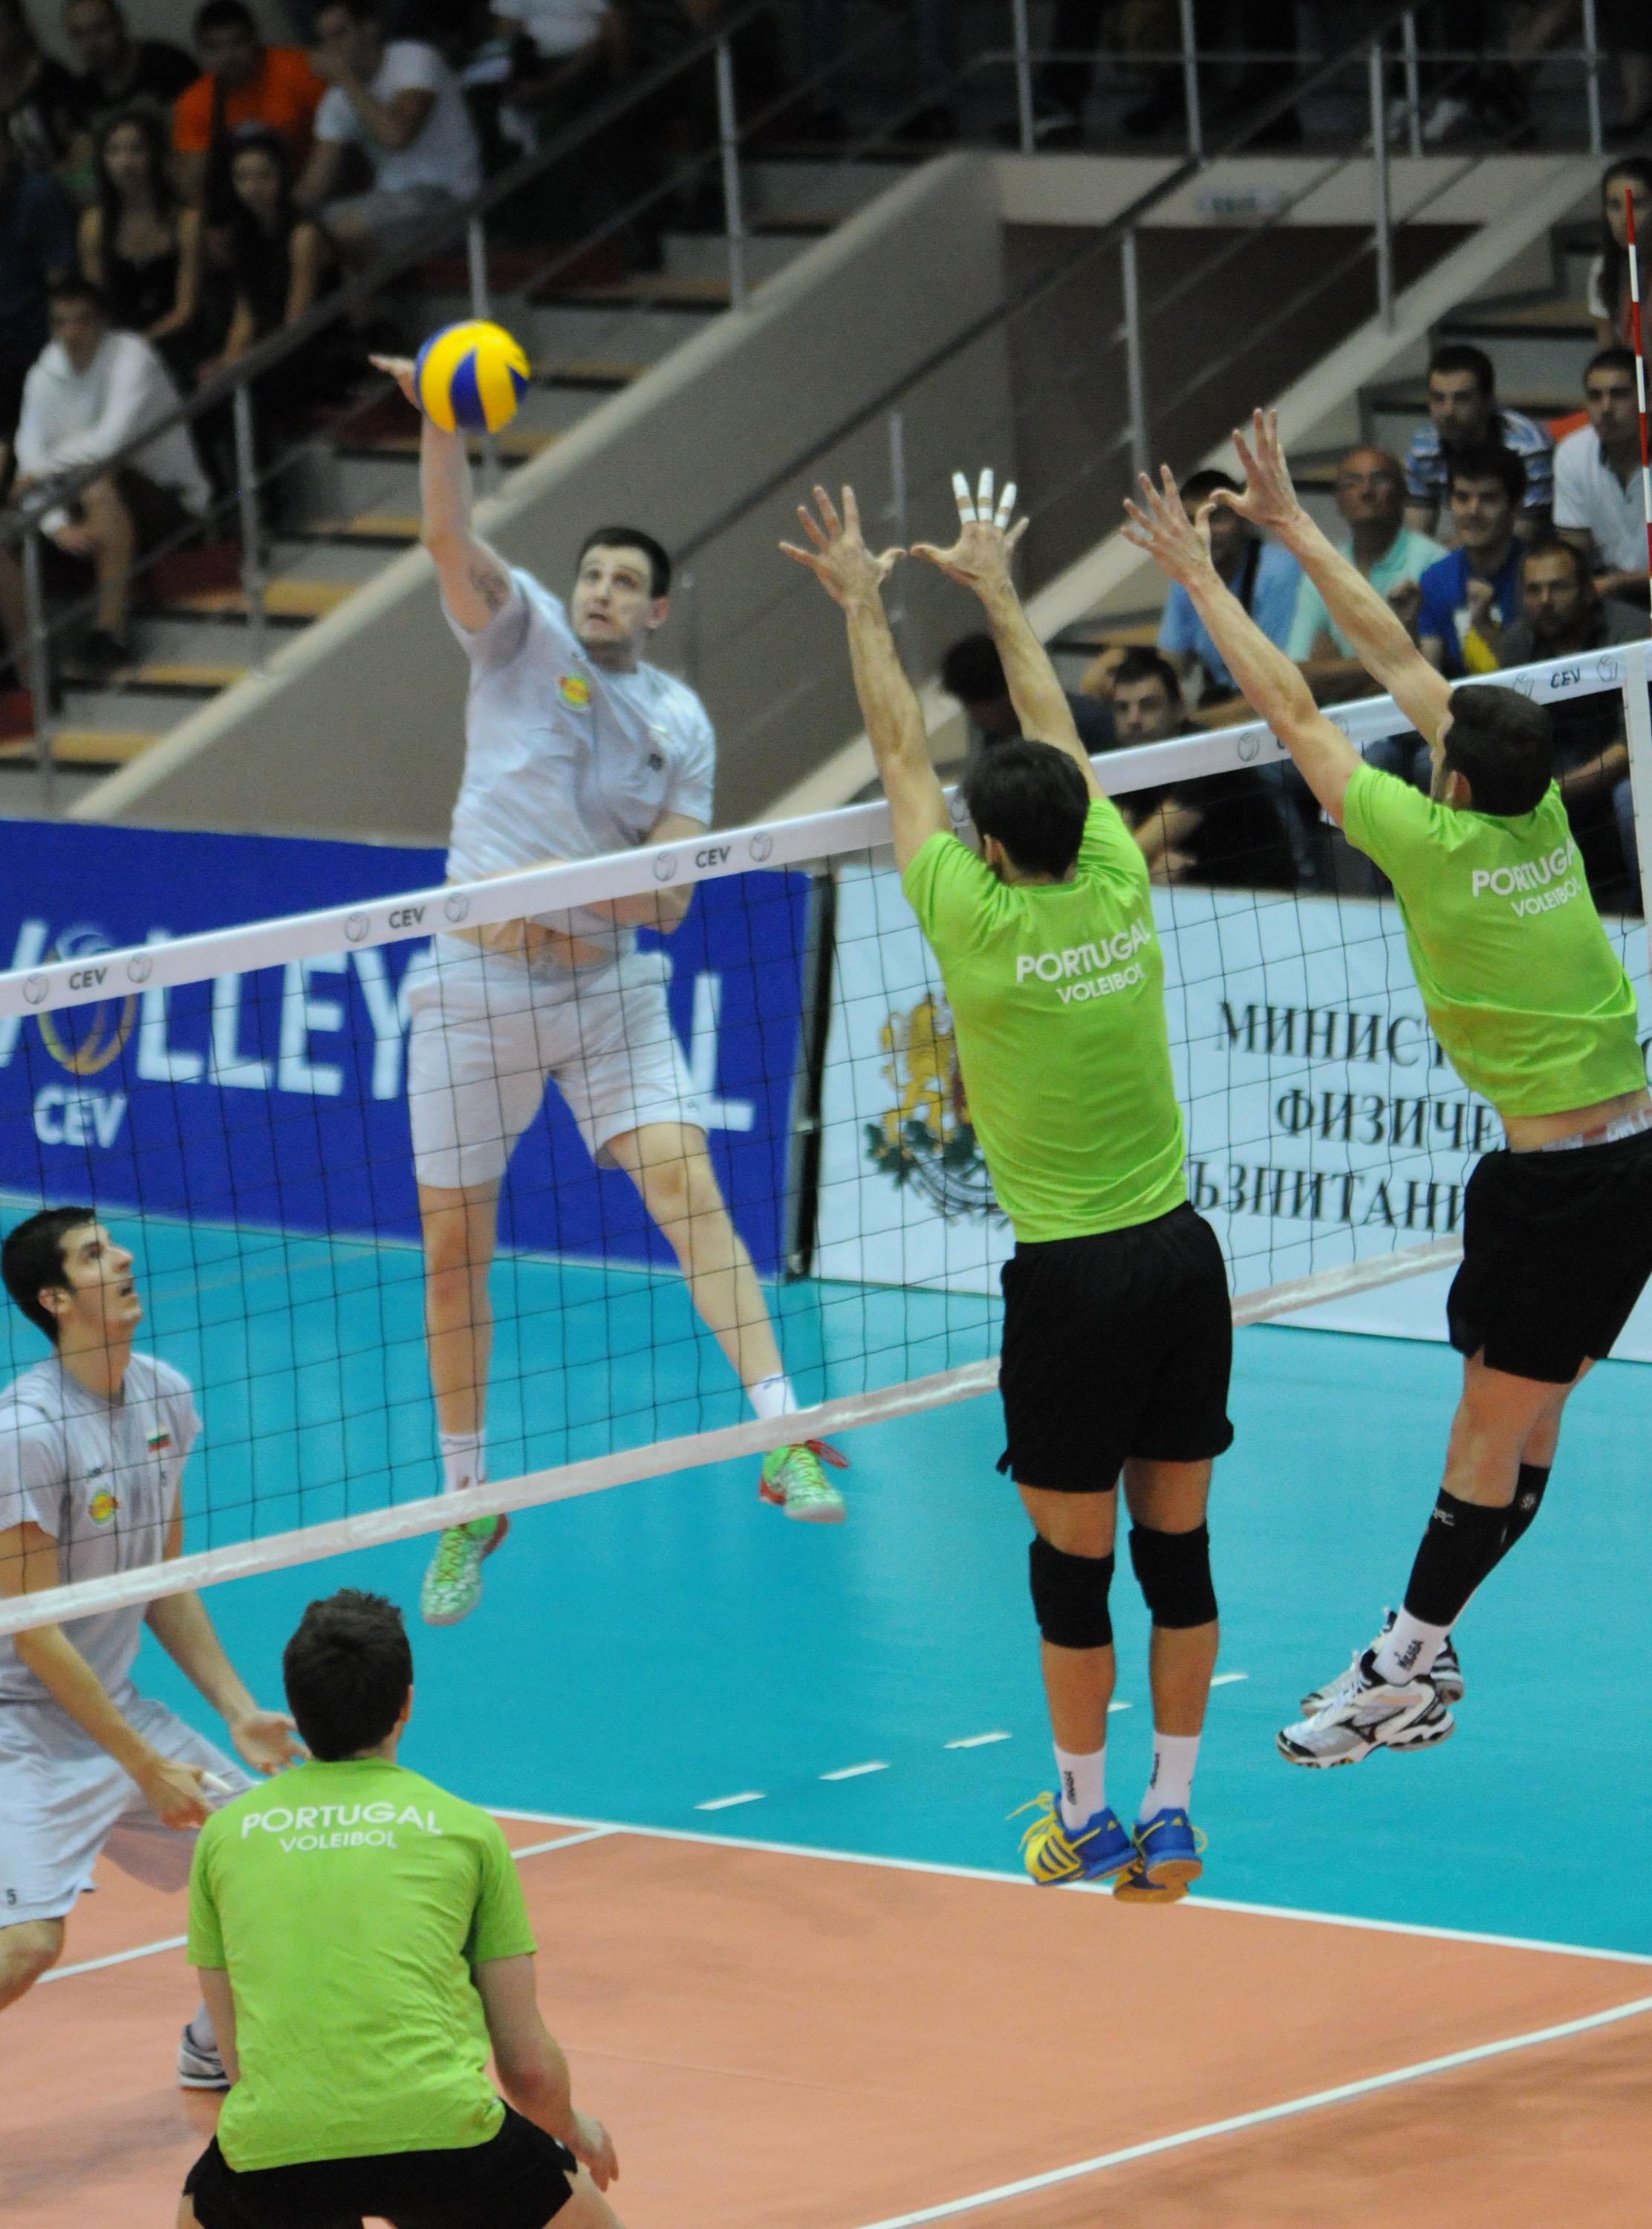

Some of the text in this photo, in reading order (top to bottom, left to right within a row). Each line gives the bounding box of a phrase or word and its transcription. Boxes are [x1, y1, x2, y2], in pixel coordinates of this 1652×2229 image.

[1550, 667, 1581, 689] CEV
[695, 844, 731, 868] CEV
[388, 906, 426, 929] CEV
[1016, 917, 1152, 984] PORTUGAL
[69, 967, 107, 990] CEV
[1056, 963, 1145, 1004] VOLEIBOL
[1215, 1000, 1446, 1068] МИНИС
[33, 1084, 128, 1148] CEV
[241, 1802, 443, 1839] PORTUGAL
[279, 1829, 397, 1853] VOLEIBOL
[6, 1888, 17, 1906] 5
